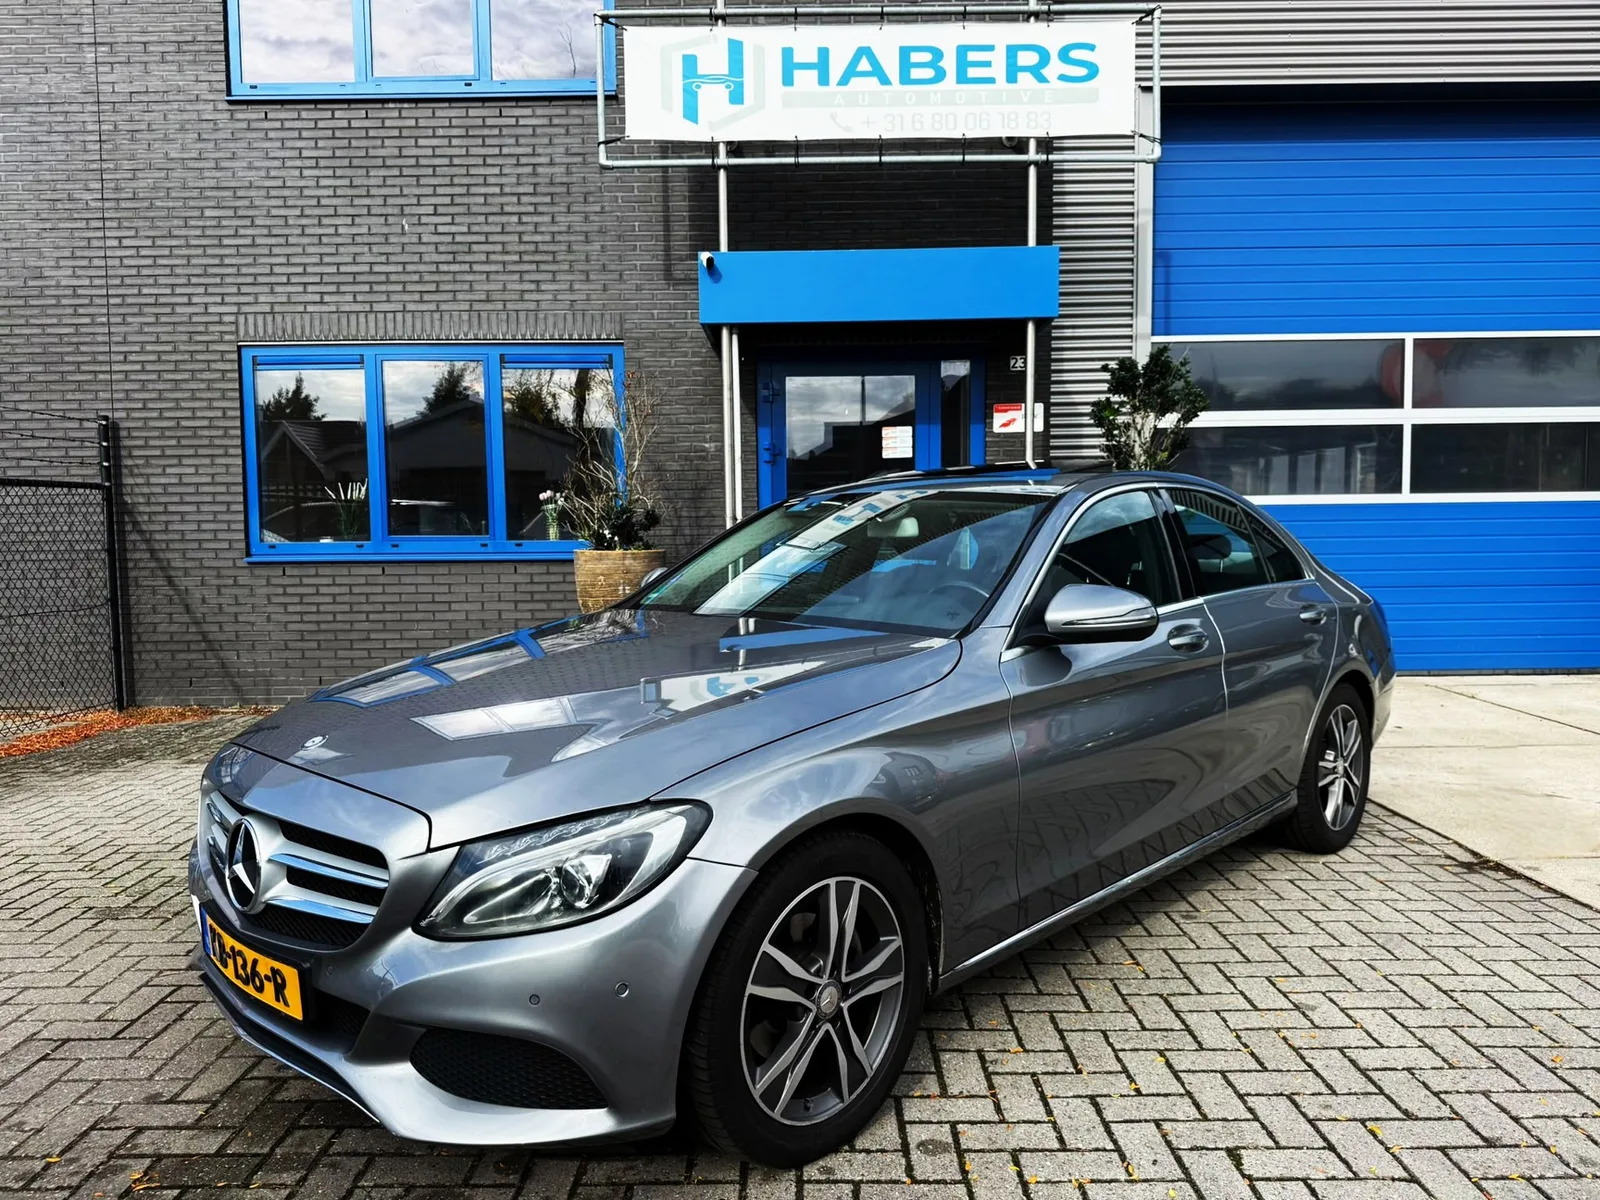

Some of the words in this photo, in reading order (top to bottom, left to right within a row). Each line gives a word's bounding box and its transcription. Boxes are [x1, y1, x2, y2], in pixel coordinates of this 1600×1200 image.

[781, 42, 1100, 87] HABERS
[833, 90, 1054, 106] AUTOMOTIVE
[931, 112, 958, 131] 80
[964, 111, 992, 131] 06
[1026, 110, 1052, 130] 83
[1011, 356, 1026, 369] 23
